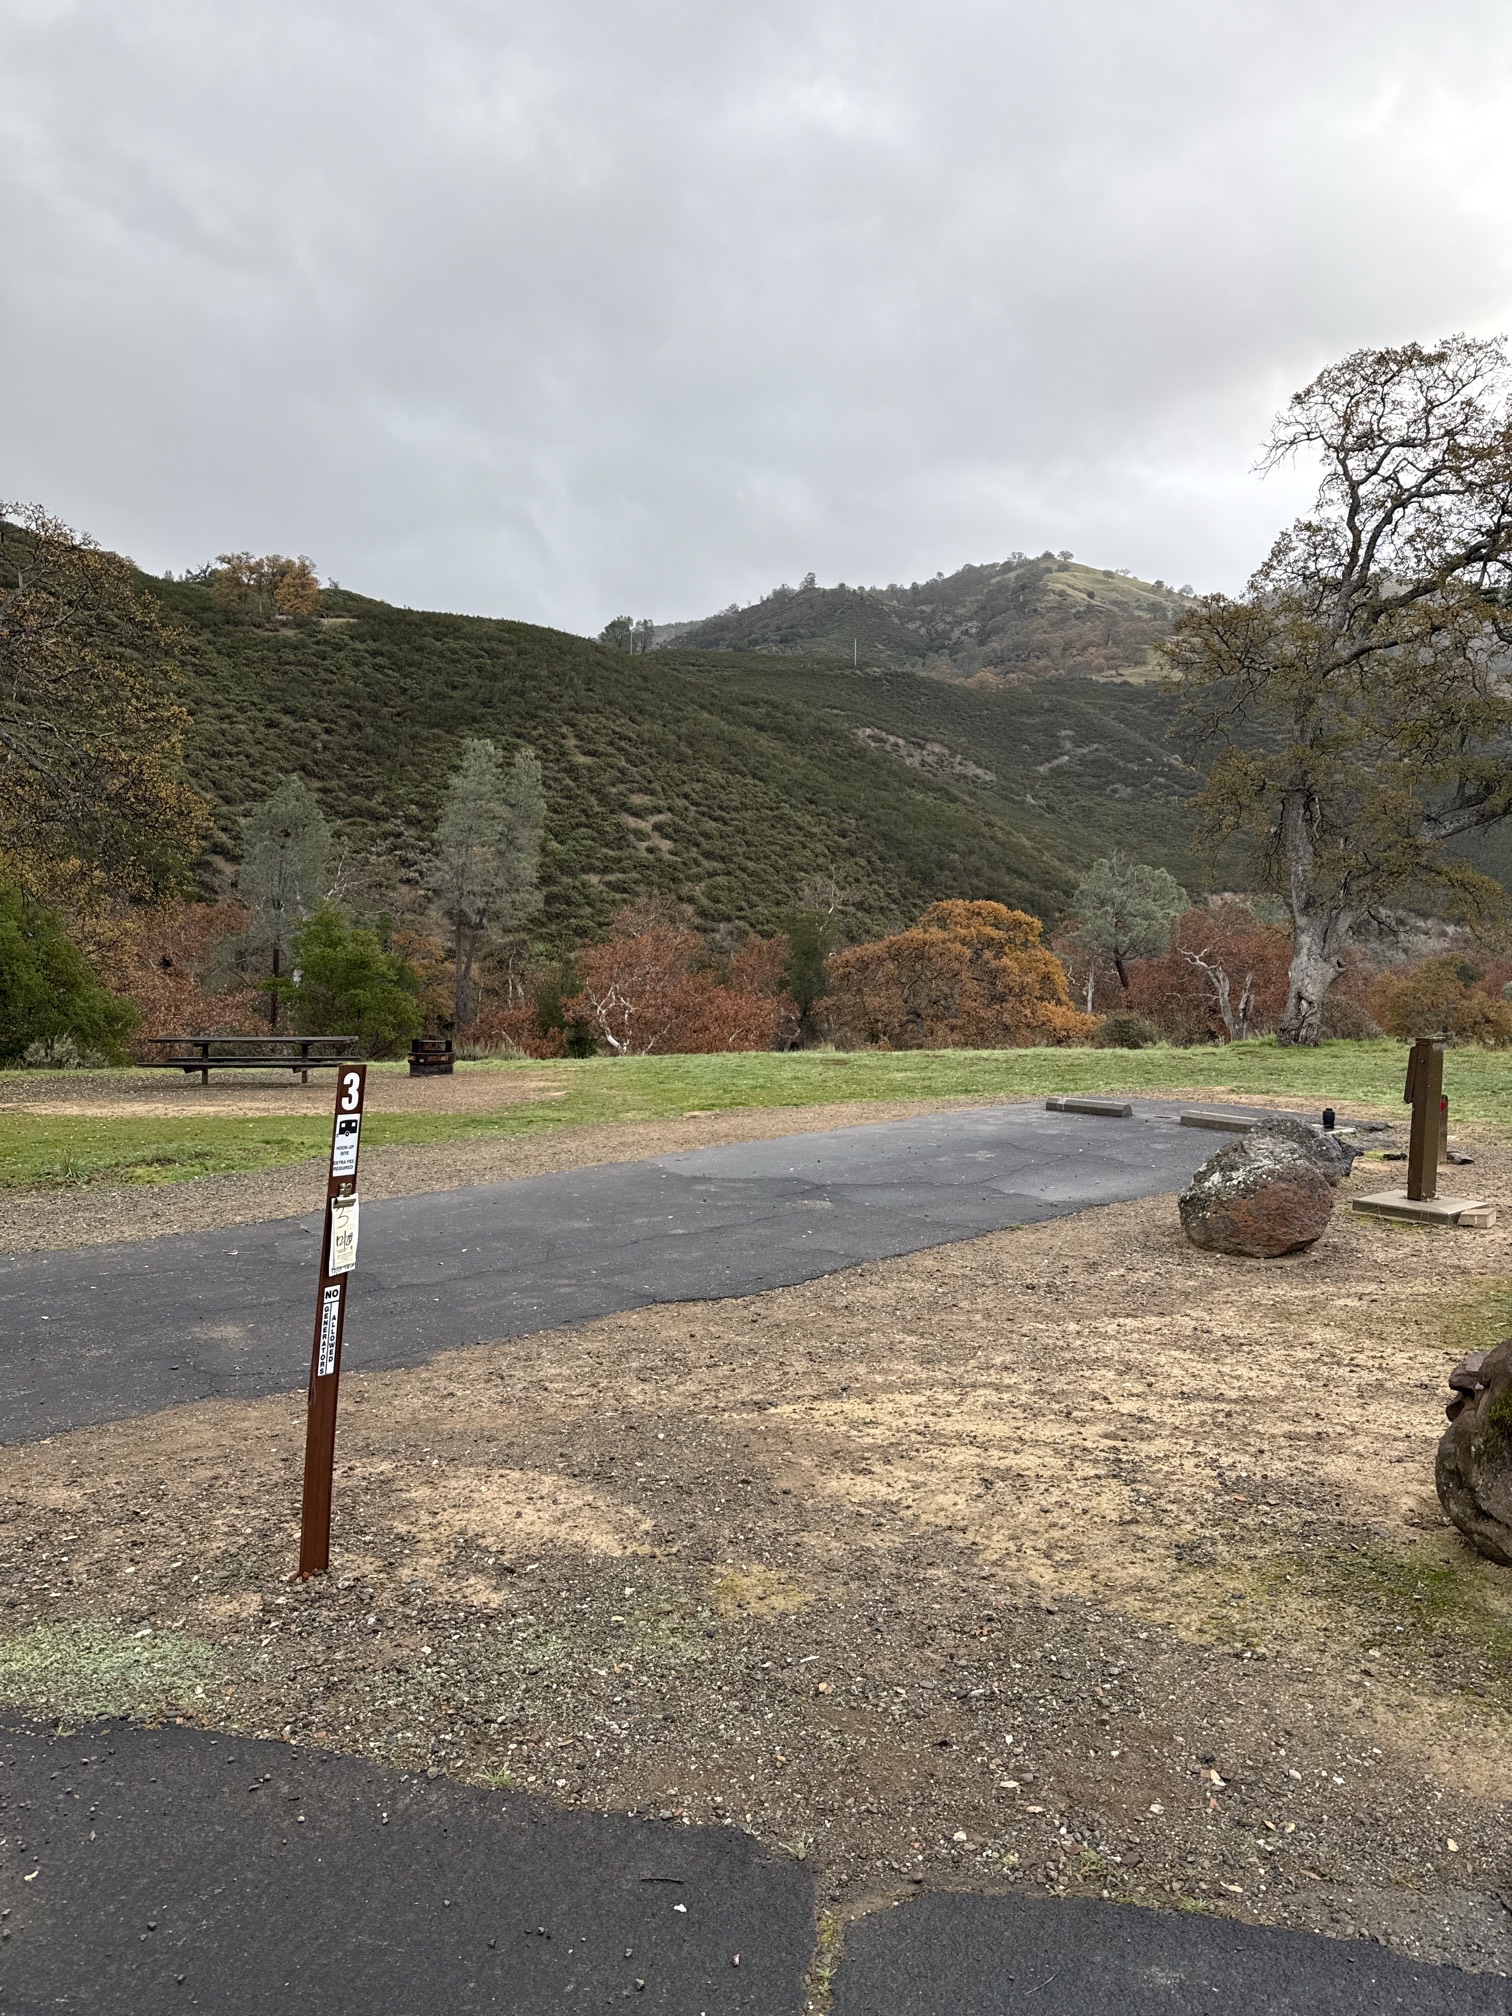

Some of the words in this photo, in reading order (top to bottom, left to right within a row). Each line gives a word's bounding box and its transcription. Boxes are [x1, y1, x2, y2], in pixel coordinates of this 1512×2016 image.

[341, 1072, 360, 1111] 3
[325, 1289, 339, 1299] NO
[320, 1306, 329, 1374] GENERATORS
[328, 1315, 336, 1362] ALLOWED
